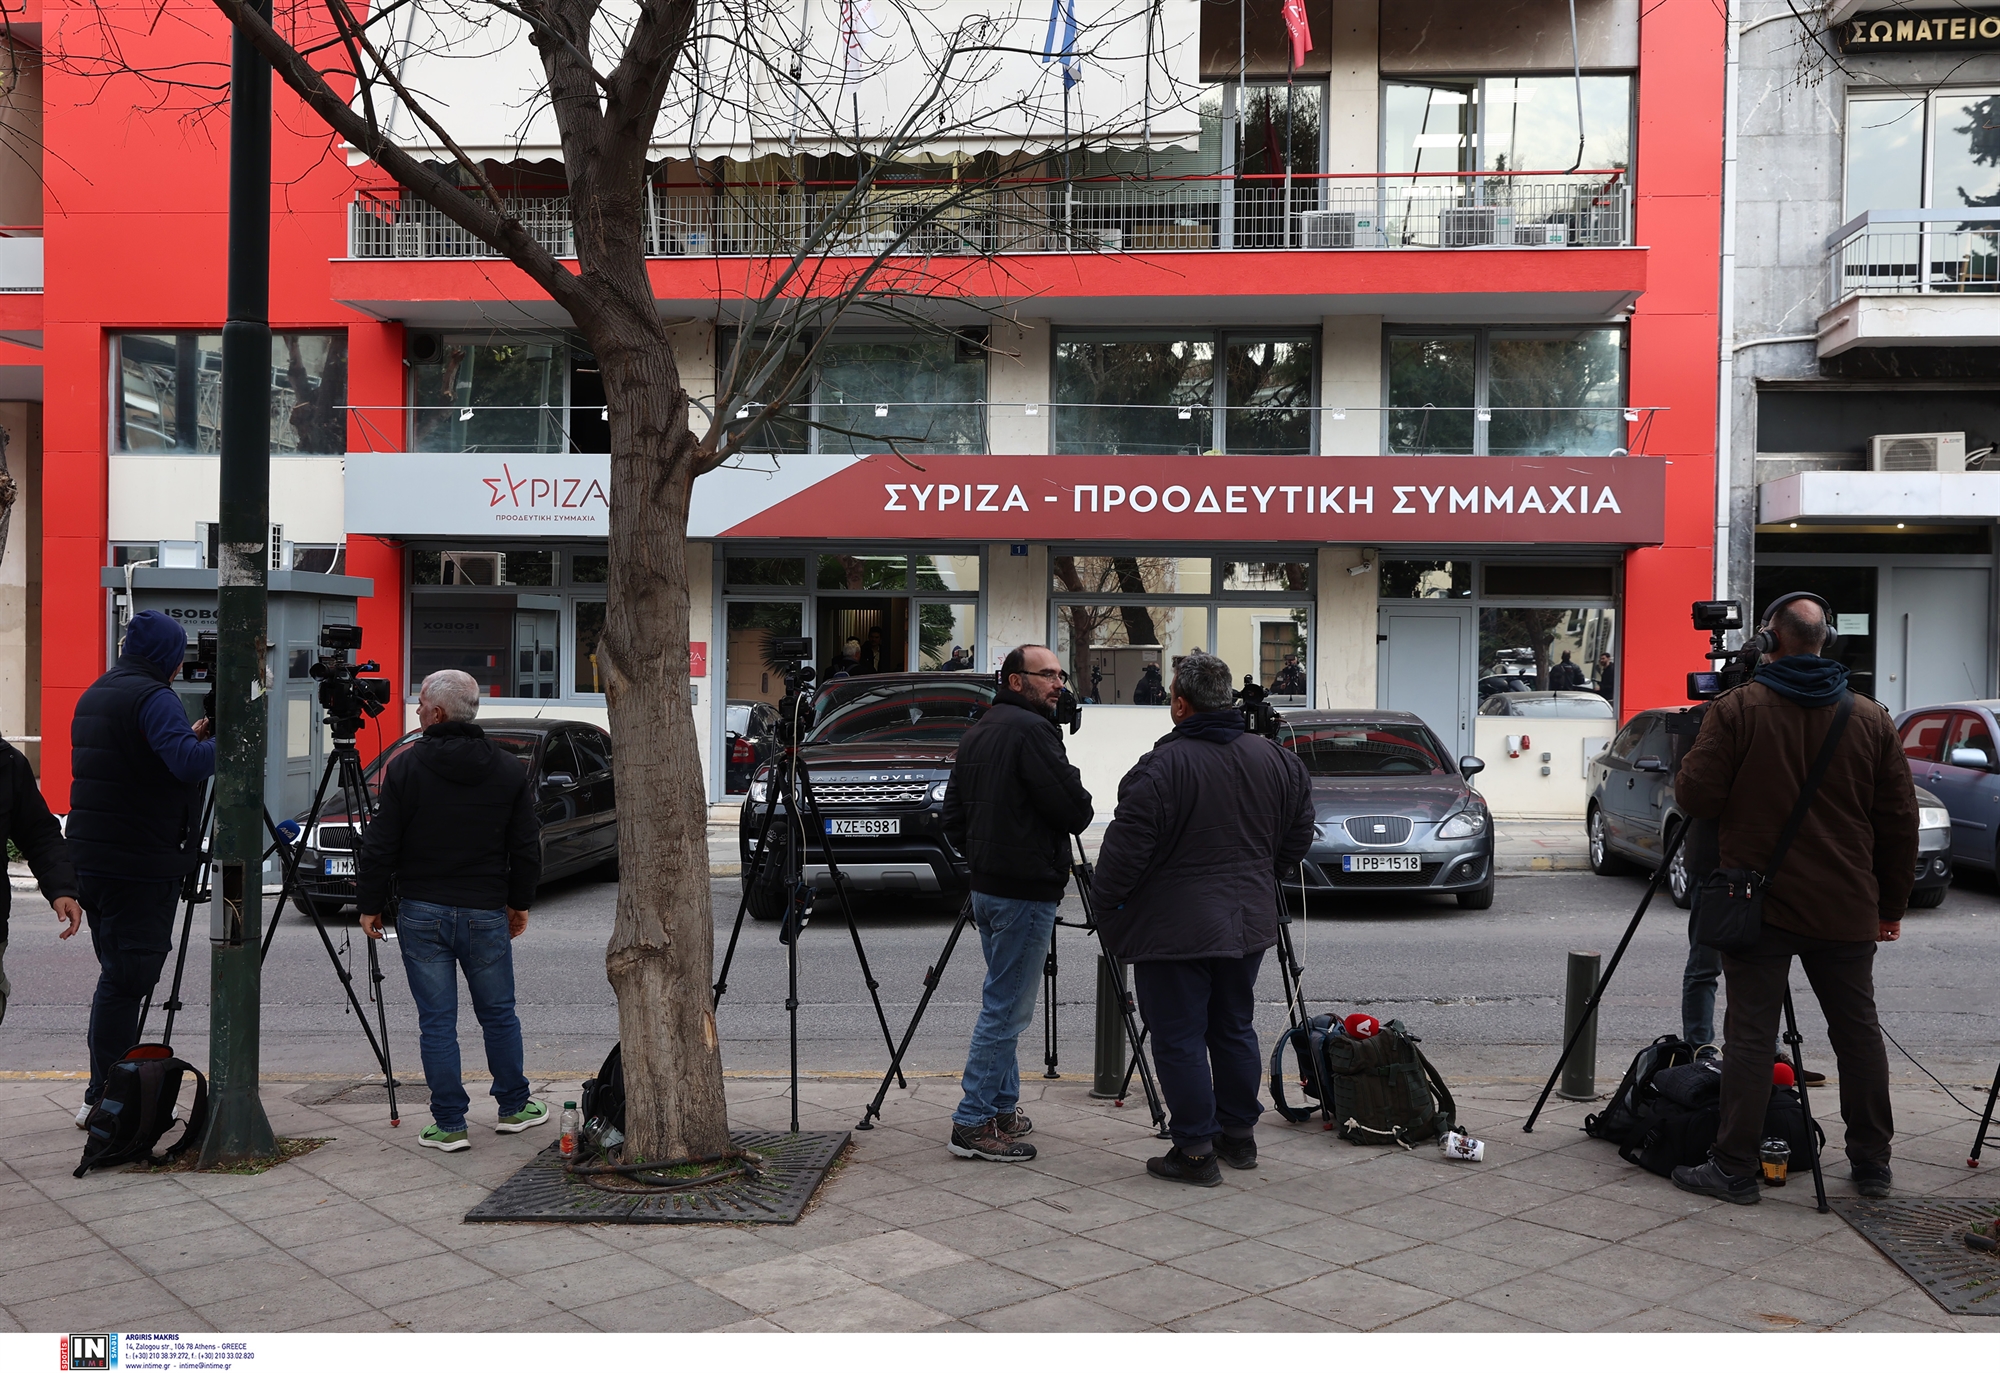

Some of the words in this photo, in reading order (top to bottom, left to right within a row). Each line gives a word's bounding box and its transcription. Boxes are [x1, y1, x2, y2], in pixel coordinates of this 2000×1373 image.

[1850, 16, 2000, 43] ΣΩΜΑΤΕΙΟ
[482, 462, 610, 508] ΣΥΡΙΖΑ
[883, 483, 1030, 512] ΣΥΡΙΖΑ
[1074, 484, 1374, 514] ΠΡΟΟΔΕΥΤΙΚΗ
[1391, 485, 1622, 514] ΣΥΜΜΑΧΙΑ
[495, 514, 552, 522] ΠΡΟΟΔΕΥΤΙΚΗ
[554, 514, 596, 522] ΣΥΜΜΑΧΙΑ
[164, 608, 219, 619] ISOB
[835, 820, 898, 834] XZE-6981
[1356, 857, 1418, 870] IPB-1518
